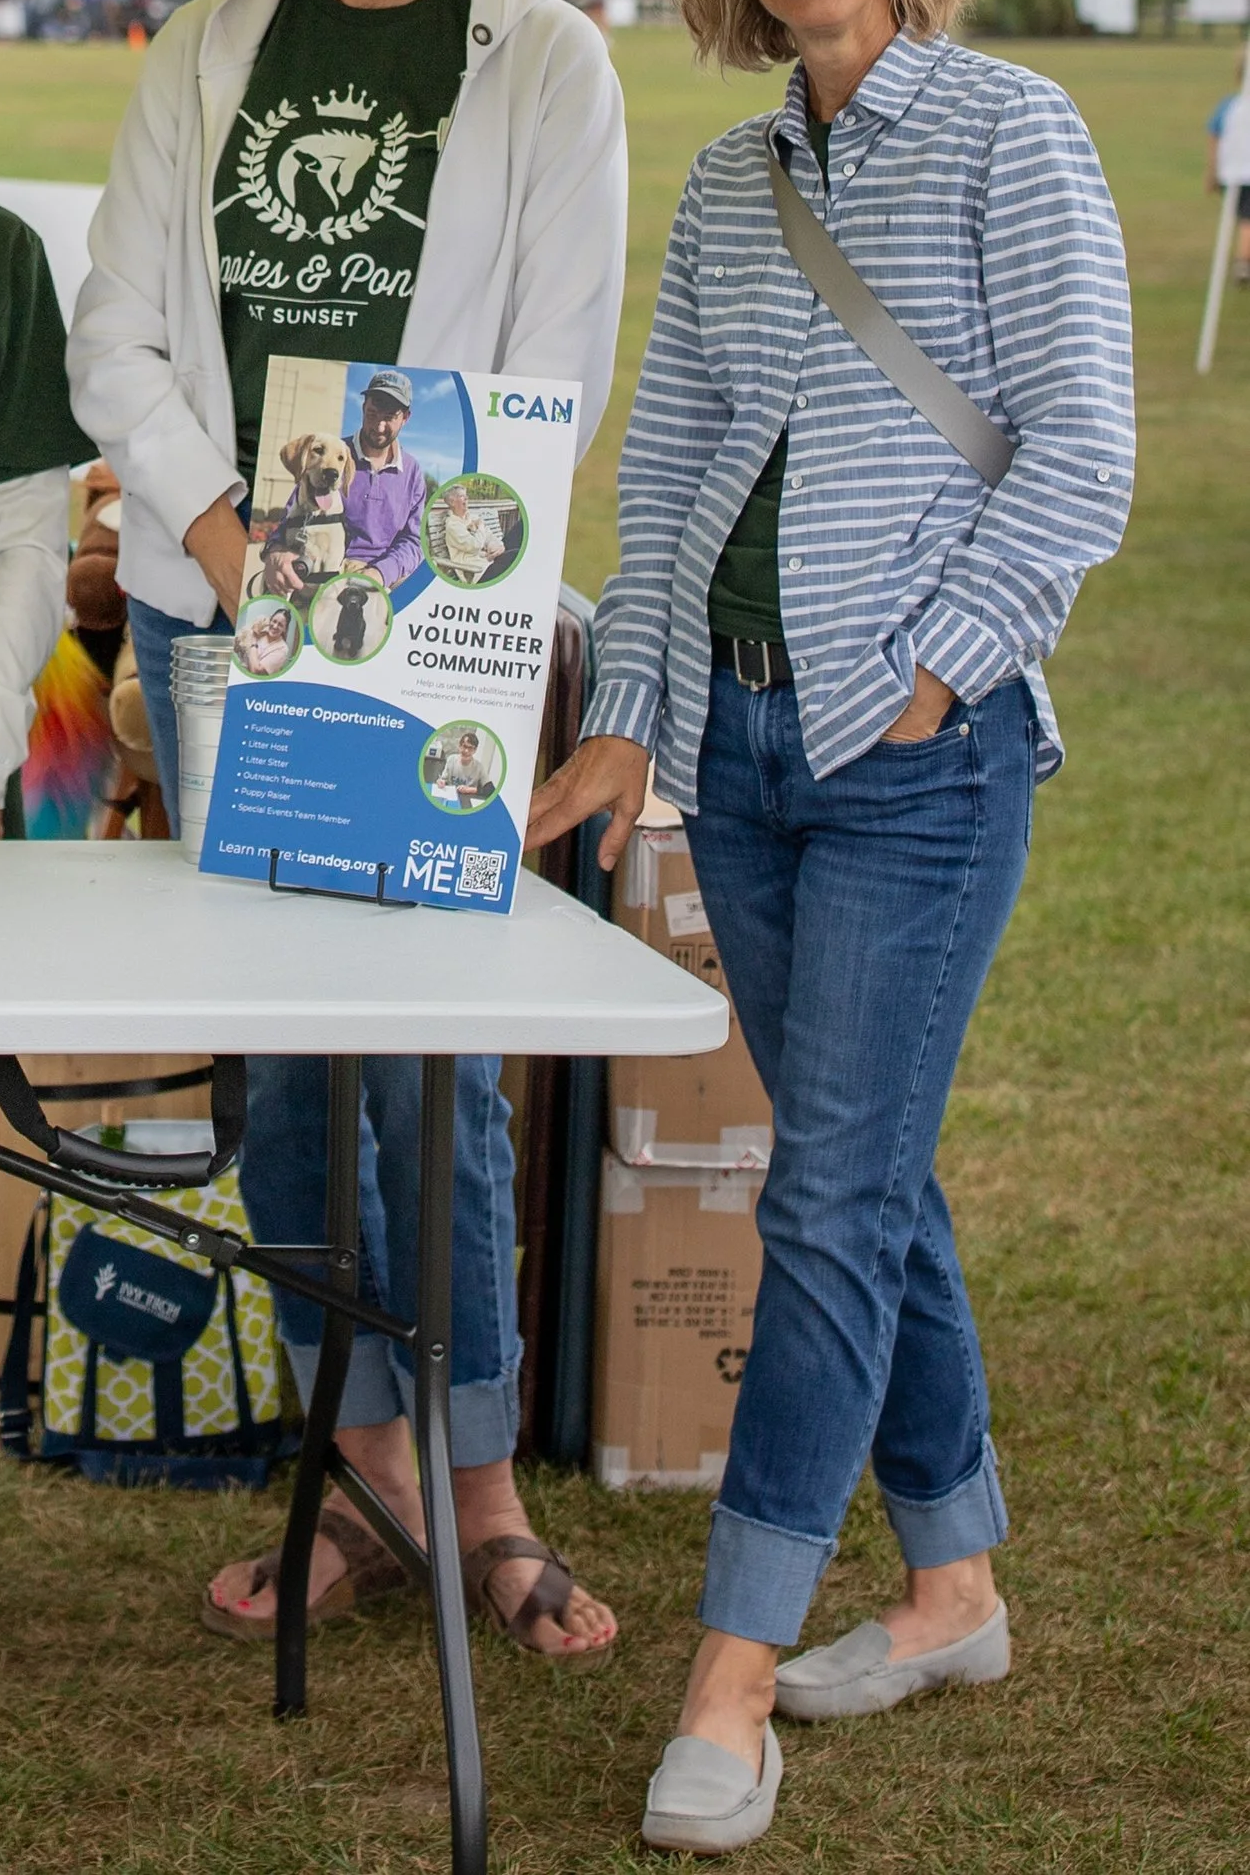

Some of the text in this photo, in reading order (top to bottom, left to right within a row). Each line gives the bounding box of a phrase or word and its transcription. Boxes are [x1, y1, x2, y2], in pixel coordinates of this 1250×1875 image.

[296, 254, 331, 293] &
[340, 253, 416, 298] Pon
[273, 307, 358, 328] SUNSET
[487, 391, 573, 424] ICAN
[428, 604, 533, 630] JOIN OUR
[408, 624, 543, 655] VOLUNTEER
[407, 650, 542, 682] COMMUNITY
[400, 689, 456, 702] independence
[457, 695, 468, 703] for
[470, 697, 503, 707] Hoosiers
[416, 679, 435, 687] Help
[446, 683, 477, 693] unleash
[478, 686, 508, 696] abilities
[245, 698, 406, 729] Volunteer Opportunities
[251, 724, 293, 737] Furlougher
[248, 740, 289, 752] Litter Host
[246, 756, 289, 768] Litter Sitter
[243, 771, 338, 790] Outreach Team Member
[240, 787, 291, 801] Puppy Raiser
[238, 803, 350, 825] Special Events Team Member
[219, 840, 254, 856] Learn
[257, 848, 295, 862] mre:
[297, 850, 377, 875] icandog.org
[409, 839, 458, 860] SCAN
[402, 856, 455, 893] ME
